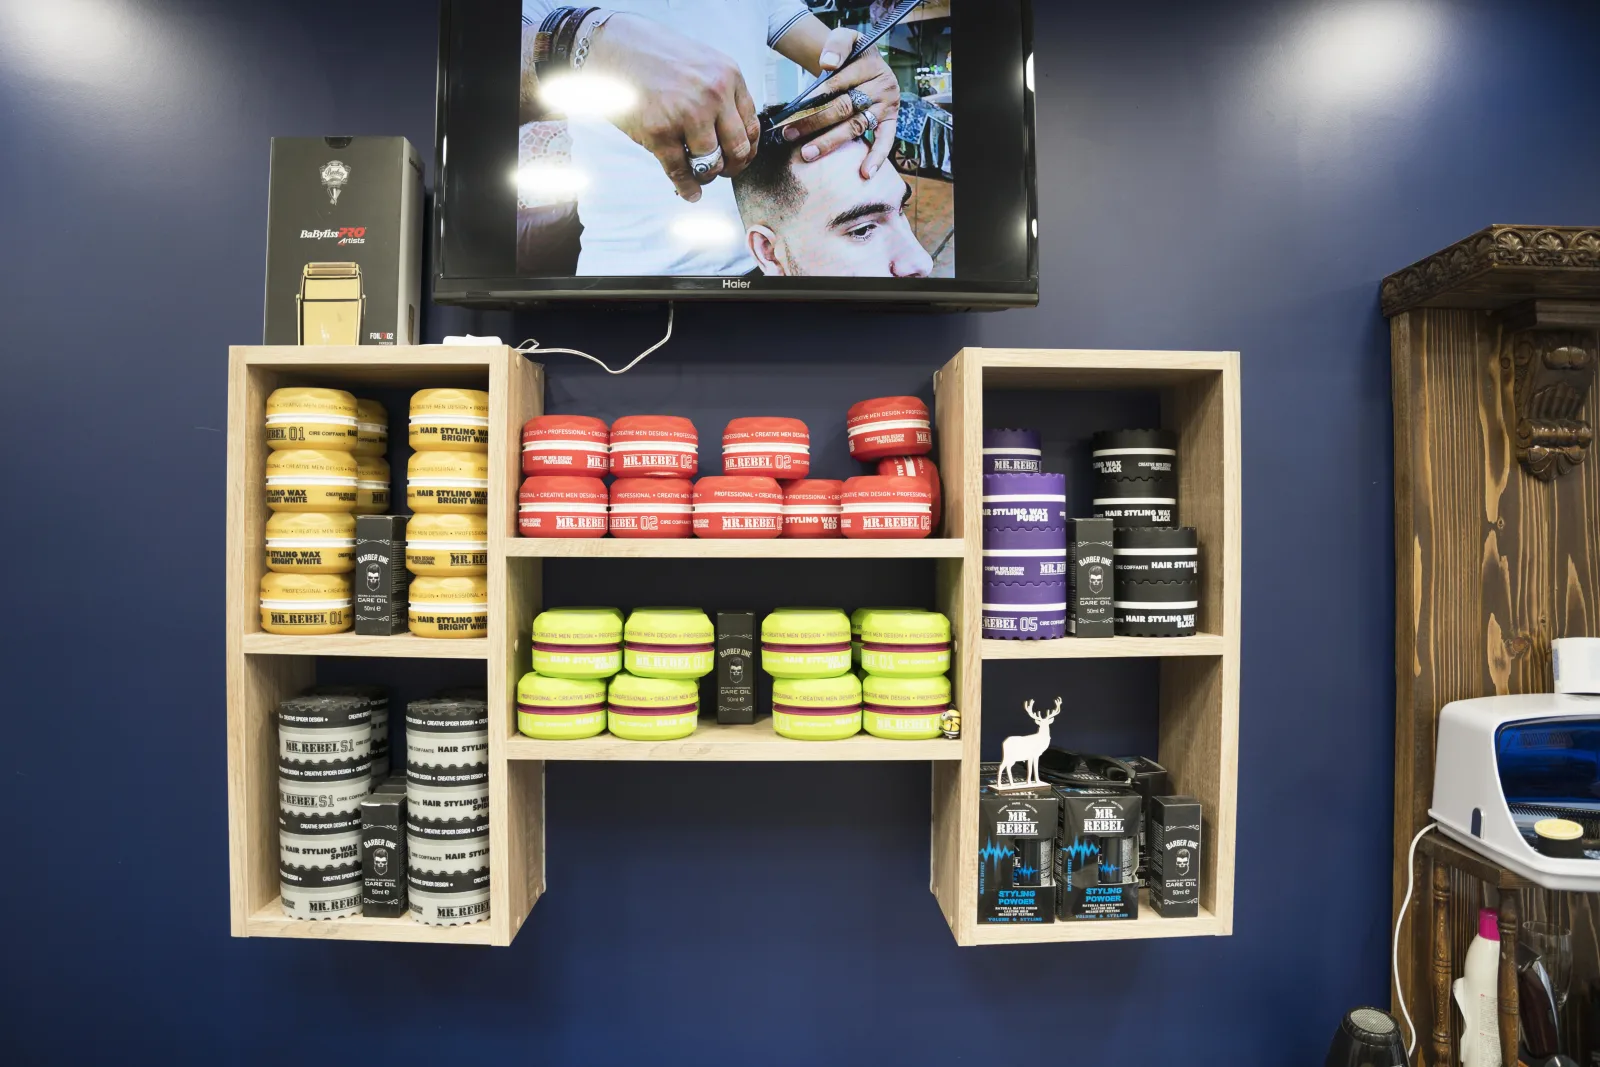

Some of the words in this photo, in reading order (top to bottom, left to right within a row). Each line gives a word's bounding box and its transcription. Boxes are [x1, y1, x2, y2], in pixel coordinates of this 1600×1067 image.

[338, 237, 365, 245] Artists
[723, 279, 751, 289] Haier
[870, 412, 881, 420] MEN
[289, 427, 305, 441] 01
[440, 428, 476, 436] STYLING
[587, 455, 602, 469] MR.
[623, 454, 641, 468] MR.
[642, 454, 679, 468] REBEL
[681, 454, 692, 469] 02
[725, 457, 737, 470] MR.
[738, 455, 773, 469] REBEL
[775, 455, 792, 469] 02
[994, 459, 1013, 471] MR.
[1014, 459, 1039, 472] REBEL
[993, 508, 1027, 516] STYLING
[556, 516, 577, 530] MR.
[578, 516, 605, 530] REBEL
[641, 516, 659, 530] 02
[722, 516, 744, 530] MR.
[745, 517, 776, 530] REBEL
[863, 516, 884, 530] MR.
[884, 516, 919, 530] REBEL
[357, 554, 378, 565] BARBER
[378, 554, 389, 565] ONE
[450, 553, 472, 566] MR.
[1079, 556, 1100, 567] BARBER
[1101, 557, 1113, 567] ONE
[1040, 562, 1057, 575] MR.
[271, 612, 288, 625] MR.
[289, 612, 328, 625] REBEL
[330, 611, 343, 625] 01
[1126, 615, 1145, 623] HAIR
[1148, 615, 1182, 623] STYLING
[1020, 617, 1038, 632] 05
[720, 648, 740, 658] BARBER
[741, 649, 752, 658] ONE
[286, 741, 301, 752] MR.
[302, 741, 340, 754] REBEL
[422, 799, 441, 807] HAIR
[444, 799, 478, 807] STYLING
[1008, 810, 1031, 822] MR.
[1093, 807, 1117, 819] MR.
[996, 822, 1039, 834] REBEL
[1084, 819, 1125, 832] REBEL
[285, 845, 300, 854] HAIR
[364, 839, 385, 849] BARBER
[386, 840, 397, 850] ONE
[1166, 839, 1187, 850] BARBER
[1187, 840, 1199, 850] ONE
[331, 851, 358, 860] SPIDER
[1086, 895, 1122, 903] POWDER
[309, 901, 330, 913] MR.
[437, 907, 458, 918] MR.
